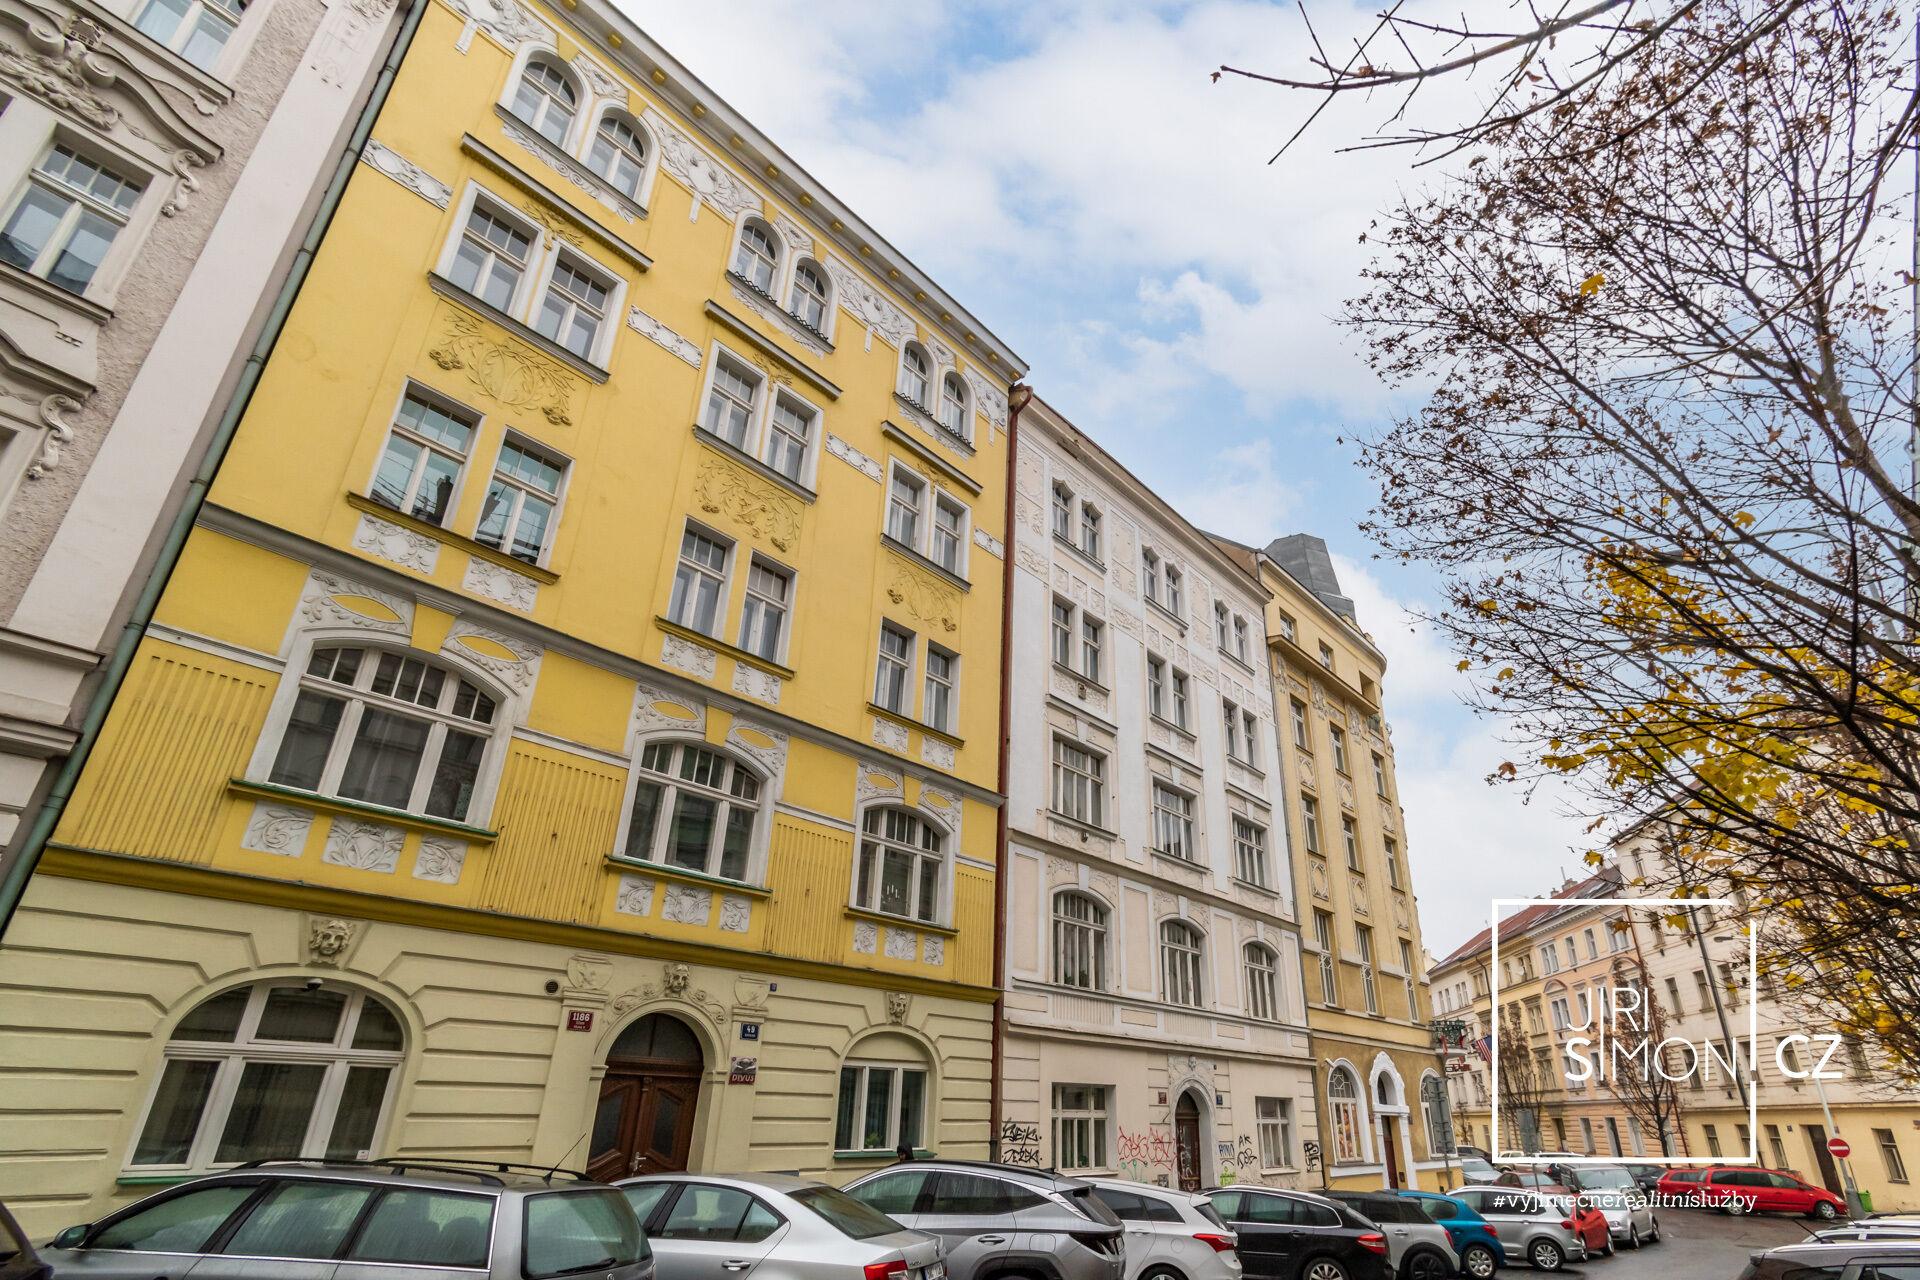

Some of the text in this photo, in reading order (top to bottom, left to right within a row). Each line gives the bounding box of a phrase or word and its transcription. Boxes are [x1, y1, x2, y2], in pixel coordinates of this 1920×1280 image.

[572, 1012, 591, 1022] 1186
[746, 1025, 756, 1034] 49
[731, 1073, 754, 1083] DIVUS
